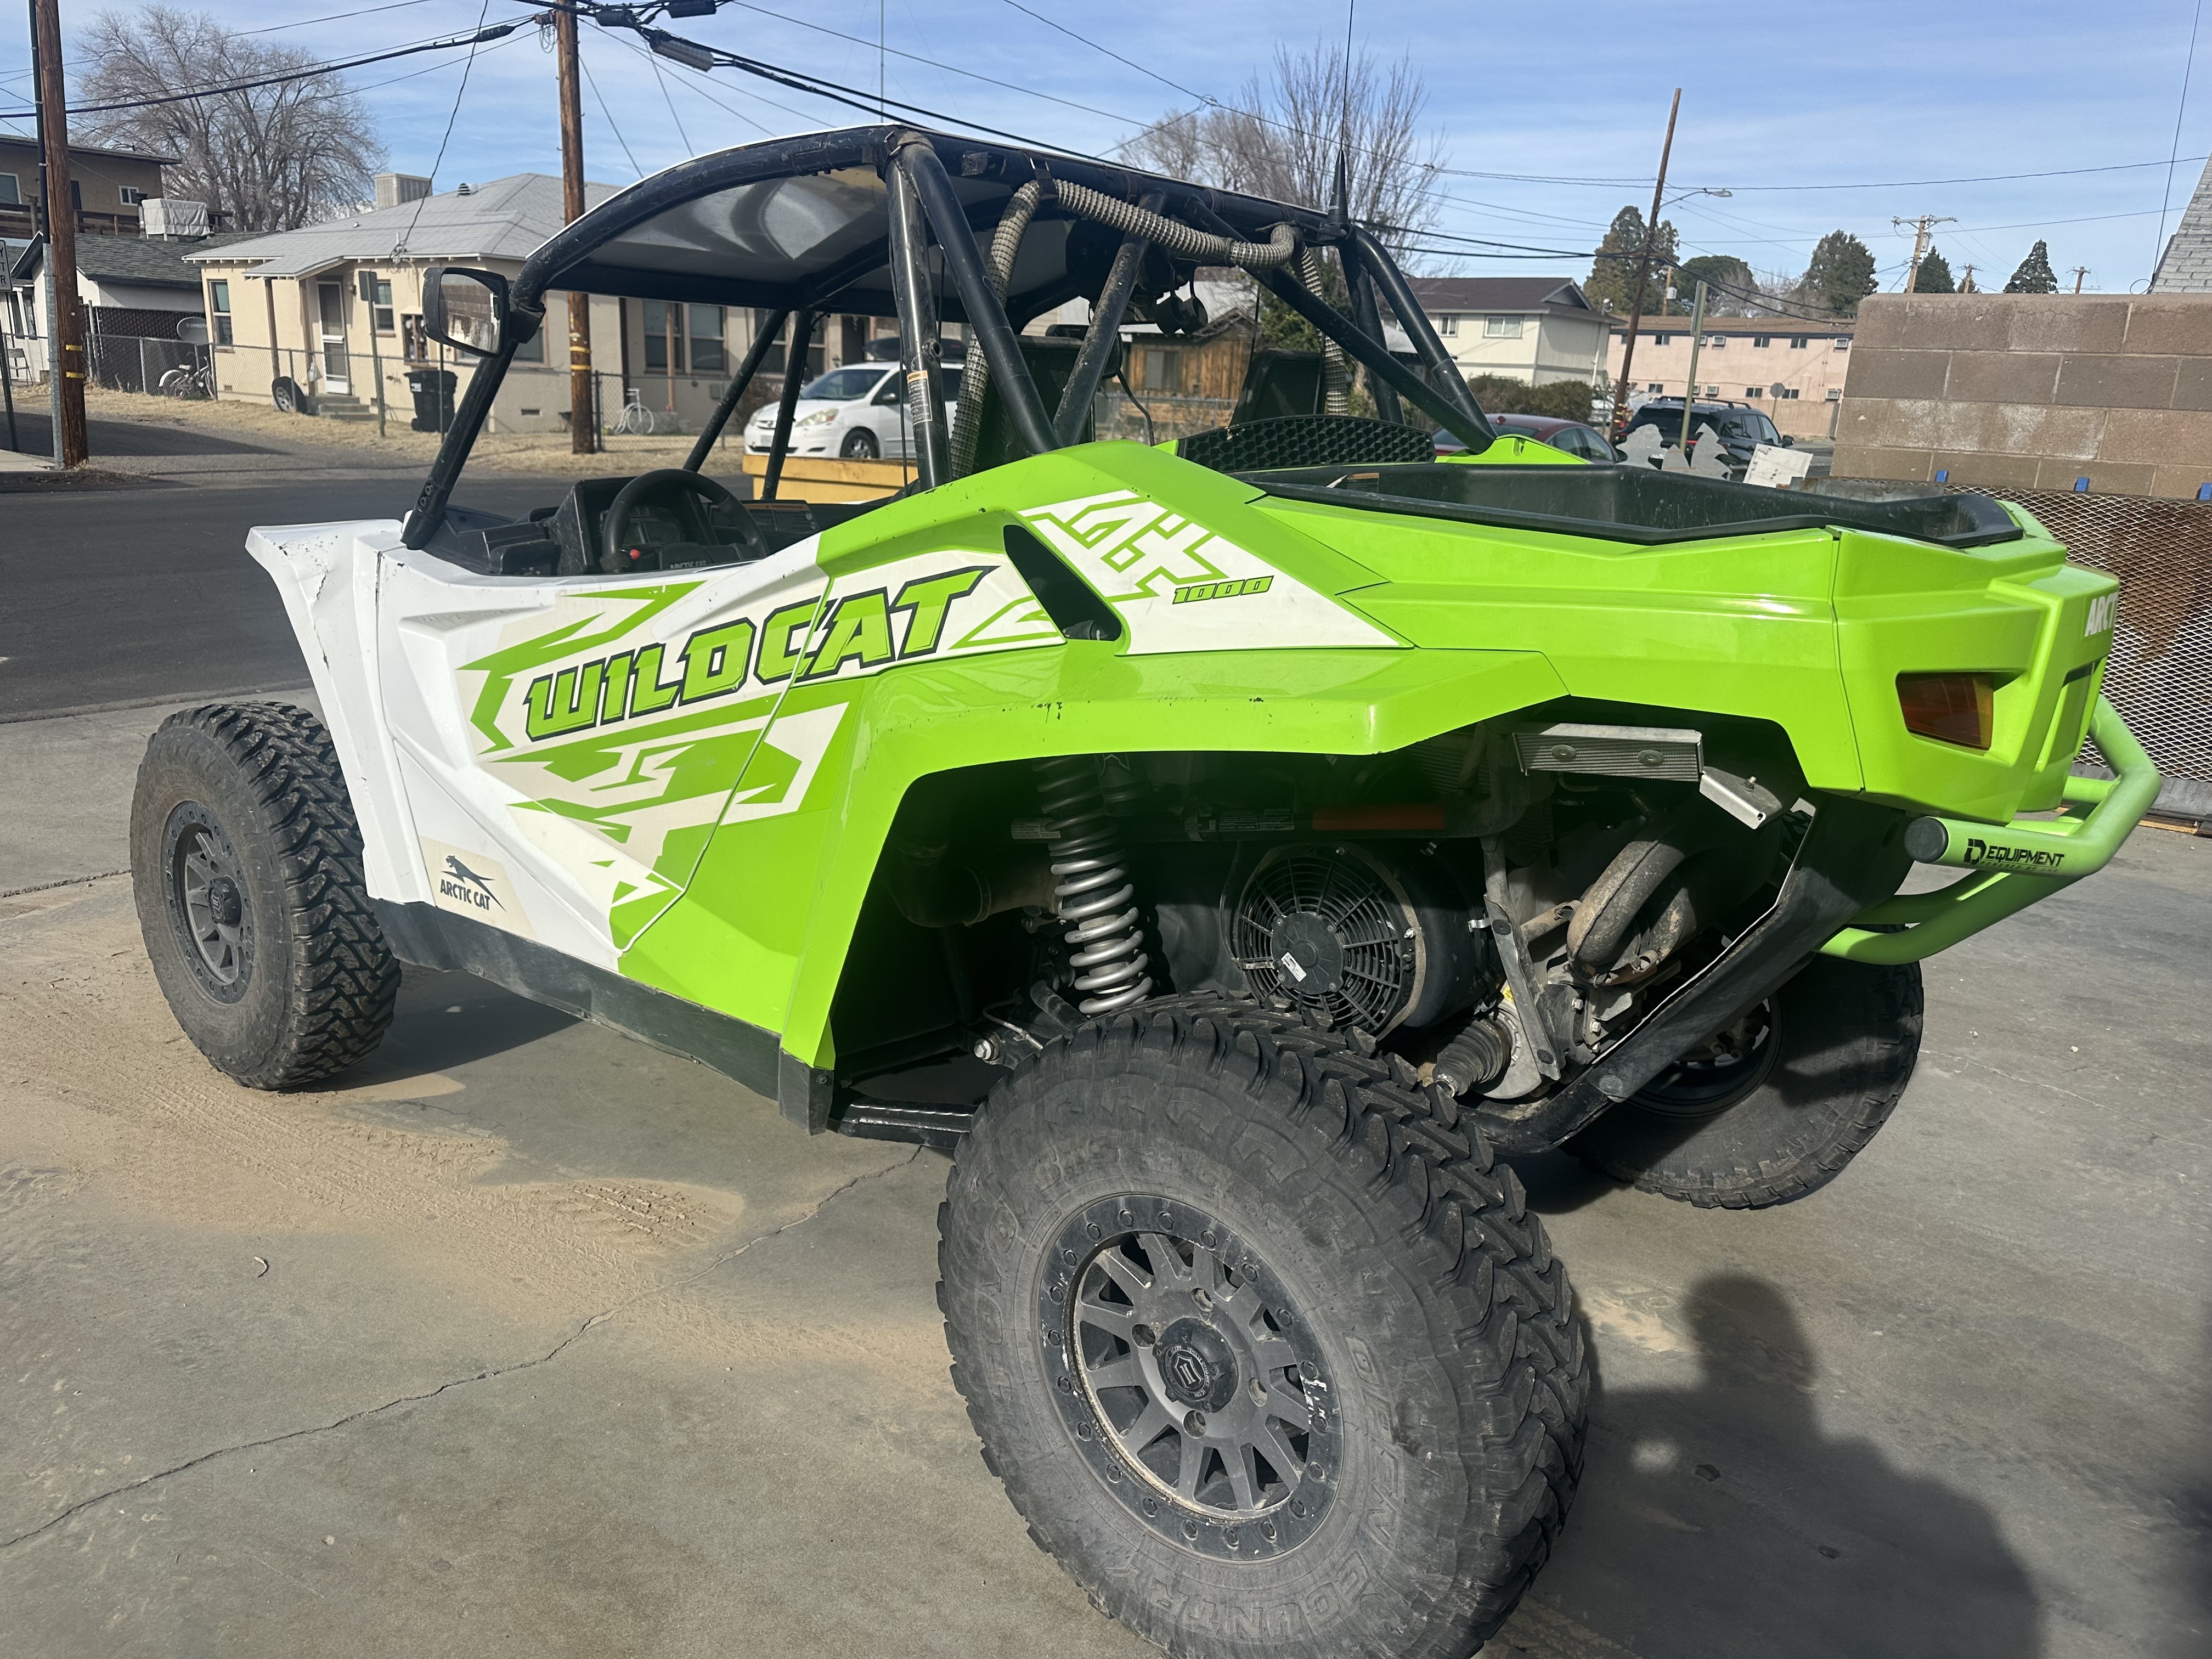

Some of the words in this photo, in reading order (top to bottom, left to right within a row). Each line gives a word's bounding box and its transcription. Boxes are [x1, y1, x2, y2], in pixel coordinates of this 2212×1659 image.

[1172, 575, 1274, 605] 1000
[523, 566, 1001, 742] WILDCAT
[1985, 845, 2064, 867] EQUIPMENT
[440, 879, 472, 904] ARCTIC
[473, 891, 490, 911] CAT
[1171, 1345, 1182, 1353] ICON
